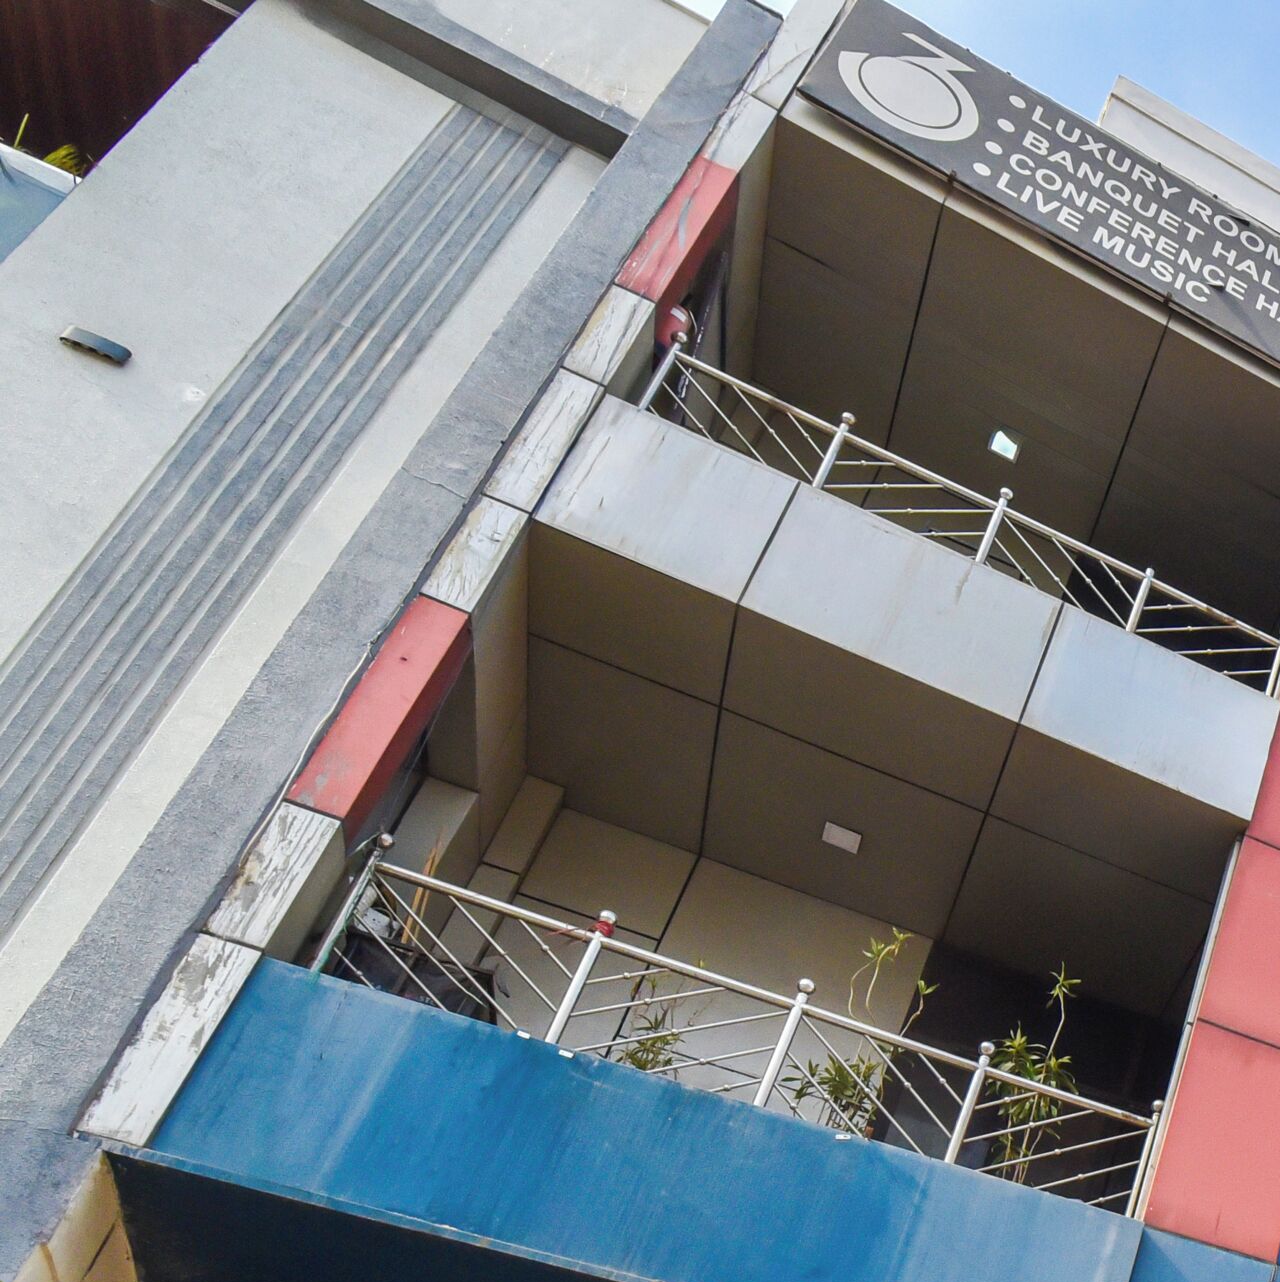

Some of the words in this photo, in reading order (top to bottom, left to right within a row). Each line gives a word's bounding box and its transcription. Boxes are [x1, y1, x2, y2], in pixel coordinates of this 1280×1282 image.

[1021, 132, 1205, 244] BANQUET
[1031, 104, 1182, 200] LUXURY
[996, 174, 1085, 233] LIVE
[1092, 225, 1211, 303] MUSIC
[1009, 153, 1249, 301] CONFERENCE
